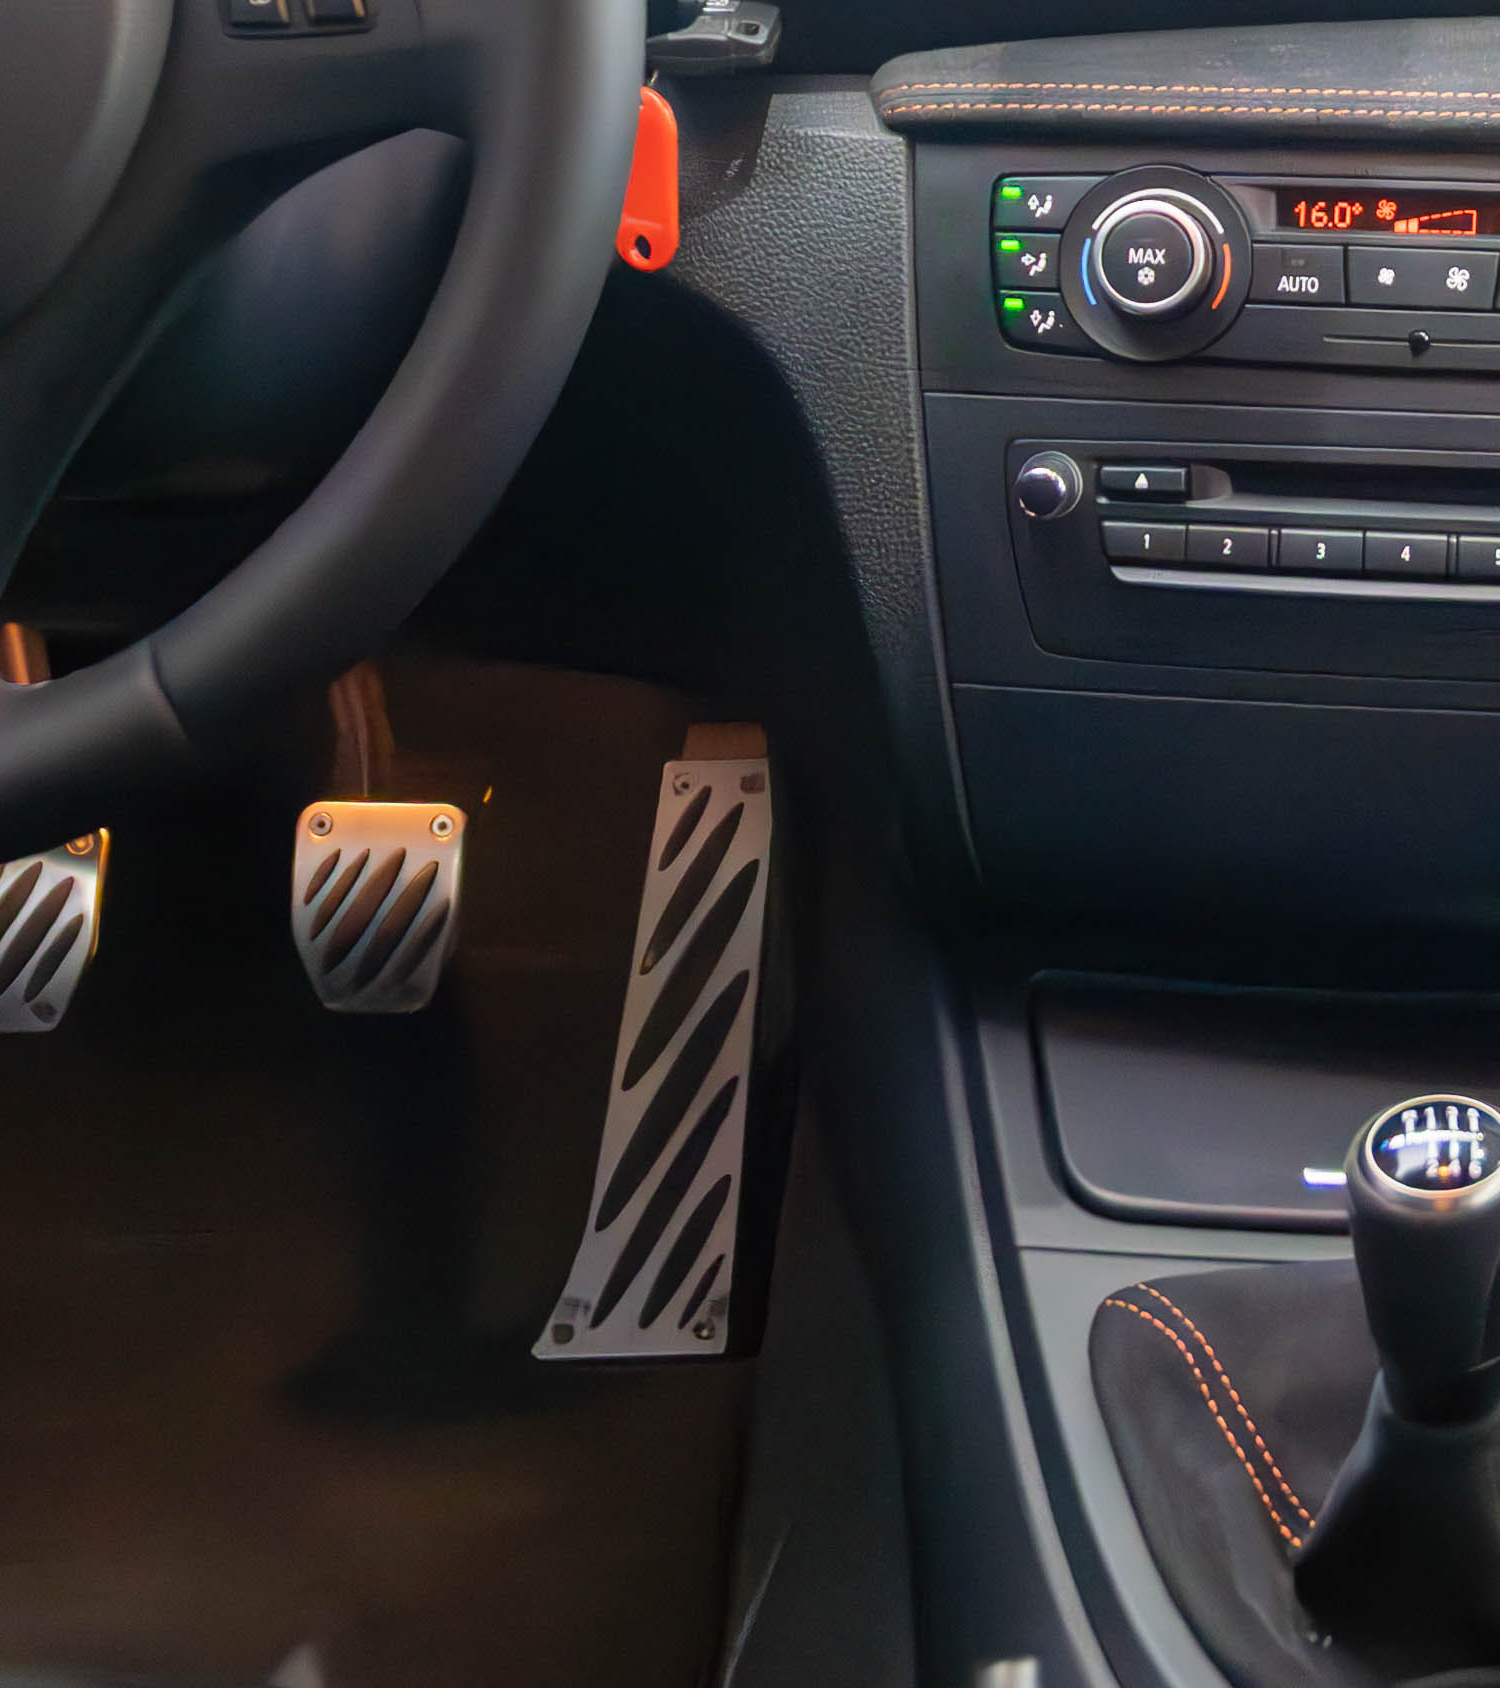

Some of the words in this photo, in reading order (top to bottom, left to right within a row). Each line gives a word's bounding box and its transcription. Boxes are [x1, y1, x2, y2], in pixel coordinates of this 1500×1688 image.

[1127, 248, 1166, 265] MAX
[1277, 275, 1320, 294] AUTO
[1143, 533, 1151, 550] 1
[1222, 538, 1232, 555] 2
[1316, 542, 1326, 560] 3
[1400, 545, 1411, 563] 4
